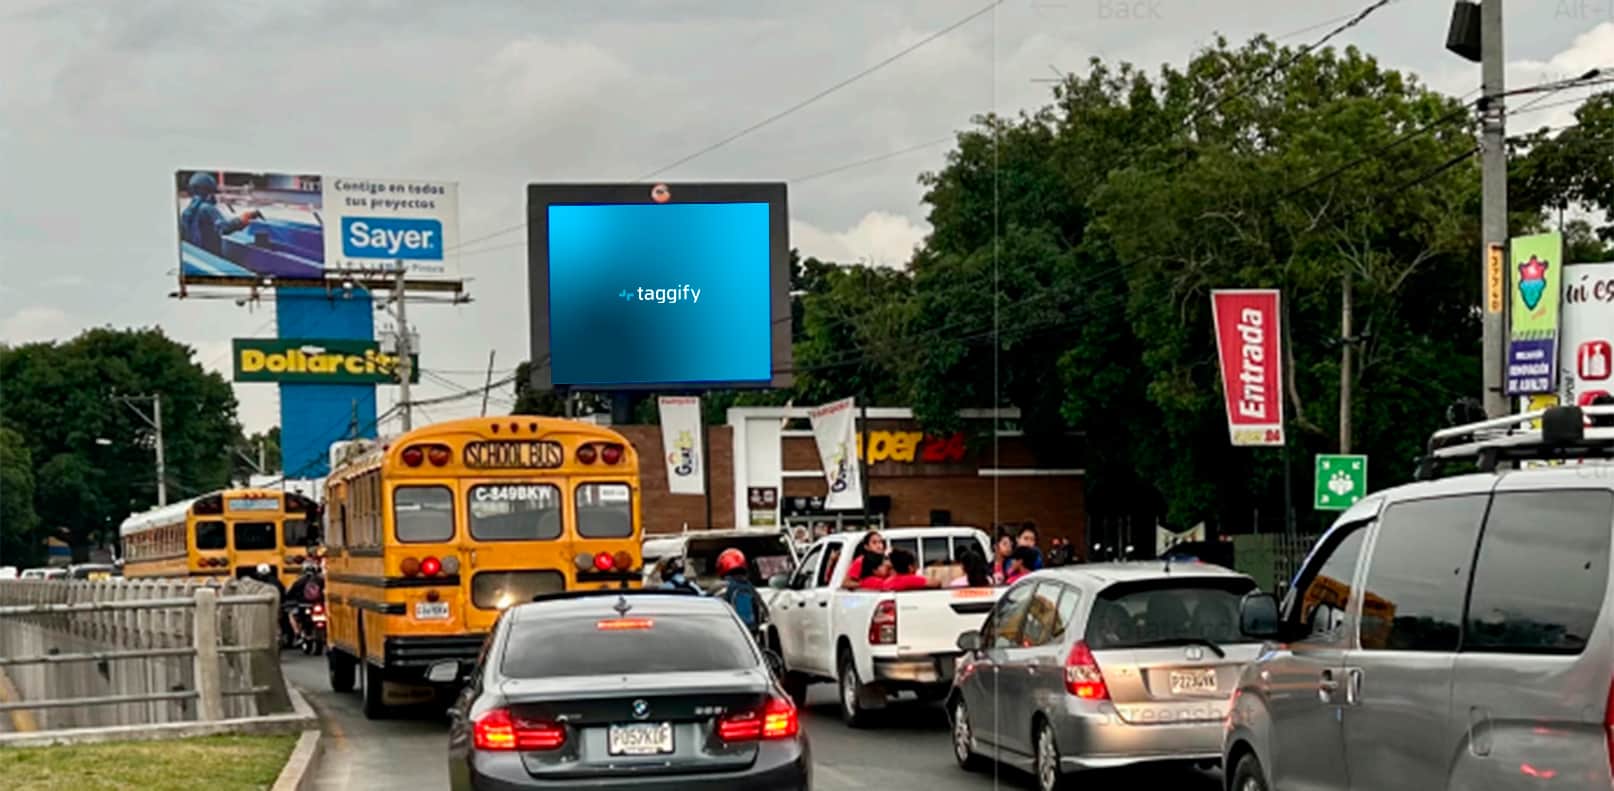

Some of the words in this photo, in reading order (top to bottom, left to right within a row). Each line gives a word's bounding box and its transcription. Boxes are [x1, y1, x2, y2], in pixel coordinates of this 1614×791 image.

[335, 180, 386, 196] Contigo
[389, 184, 405, 194] en
[408, 183, 445, 195] todos
[346, 196, 367, 207] tus
[370, 197, 435, 211] proyectos
[350, 222, 429, 254] Sayer
[637, 285, 701, 303] taggify
[1237, 308, 1266, 419] Entrada
[466, 443, 520, 465] SCHOOL
[528, 443, 560, 465] BUS
